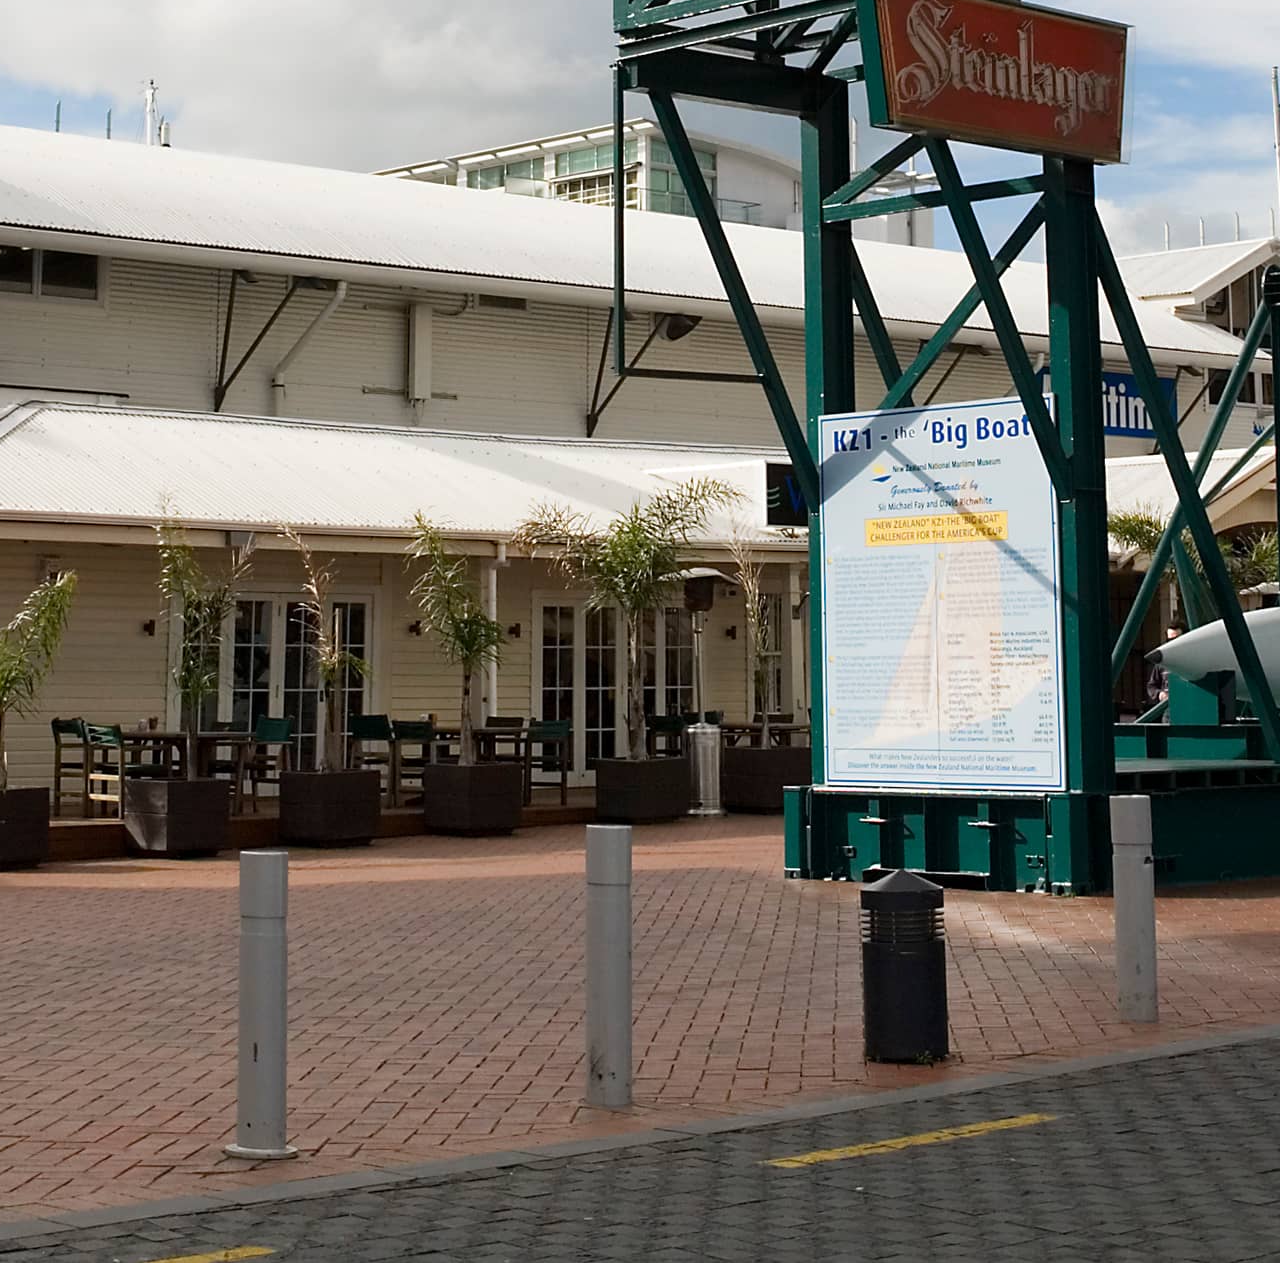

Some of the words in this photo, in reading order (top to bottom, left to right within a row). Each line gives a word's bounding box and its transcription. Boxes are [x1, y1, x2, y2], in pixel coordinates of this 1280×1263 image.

[833, 427, 872, 453] KZ1
[894, 426, 916, 441] the
[892, 463, 904, 474] New
[905, 461, 927, 473] Zealand
[927, 459, 951, 471] National
[951, 458, 976, 469] Maritime
[976, 456, 1001, 467] Museum
[890, 483, 932, 499] Generously
[933, 480, 968, 495] Donated
[969, 479, 979, 492] by
[878, 502, 887, 512] Sir
[888, 499, 914, 511] Michael
[914, 499, 925, 512] Fay
[925, 498, 939, 509] and
[939, 497, 958, 509] David
[959, 495, 993, 507] Richwhite
[870, 531, 916, 543] CHALLENGER
[916, 530, 930, 540] FOR
[931, 529, 945, 539] THE
[946, 527, 987, 538] AMERICA'S
[987, 526, 1003, 536] CUP
